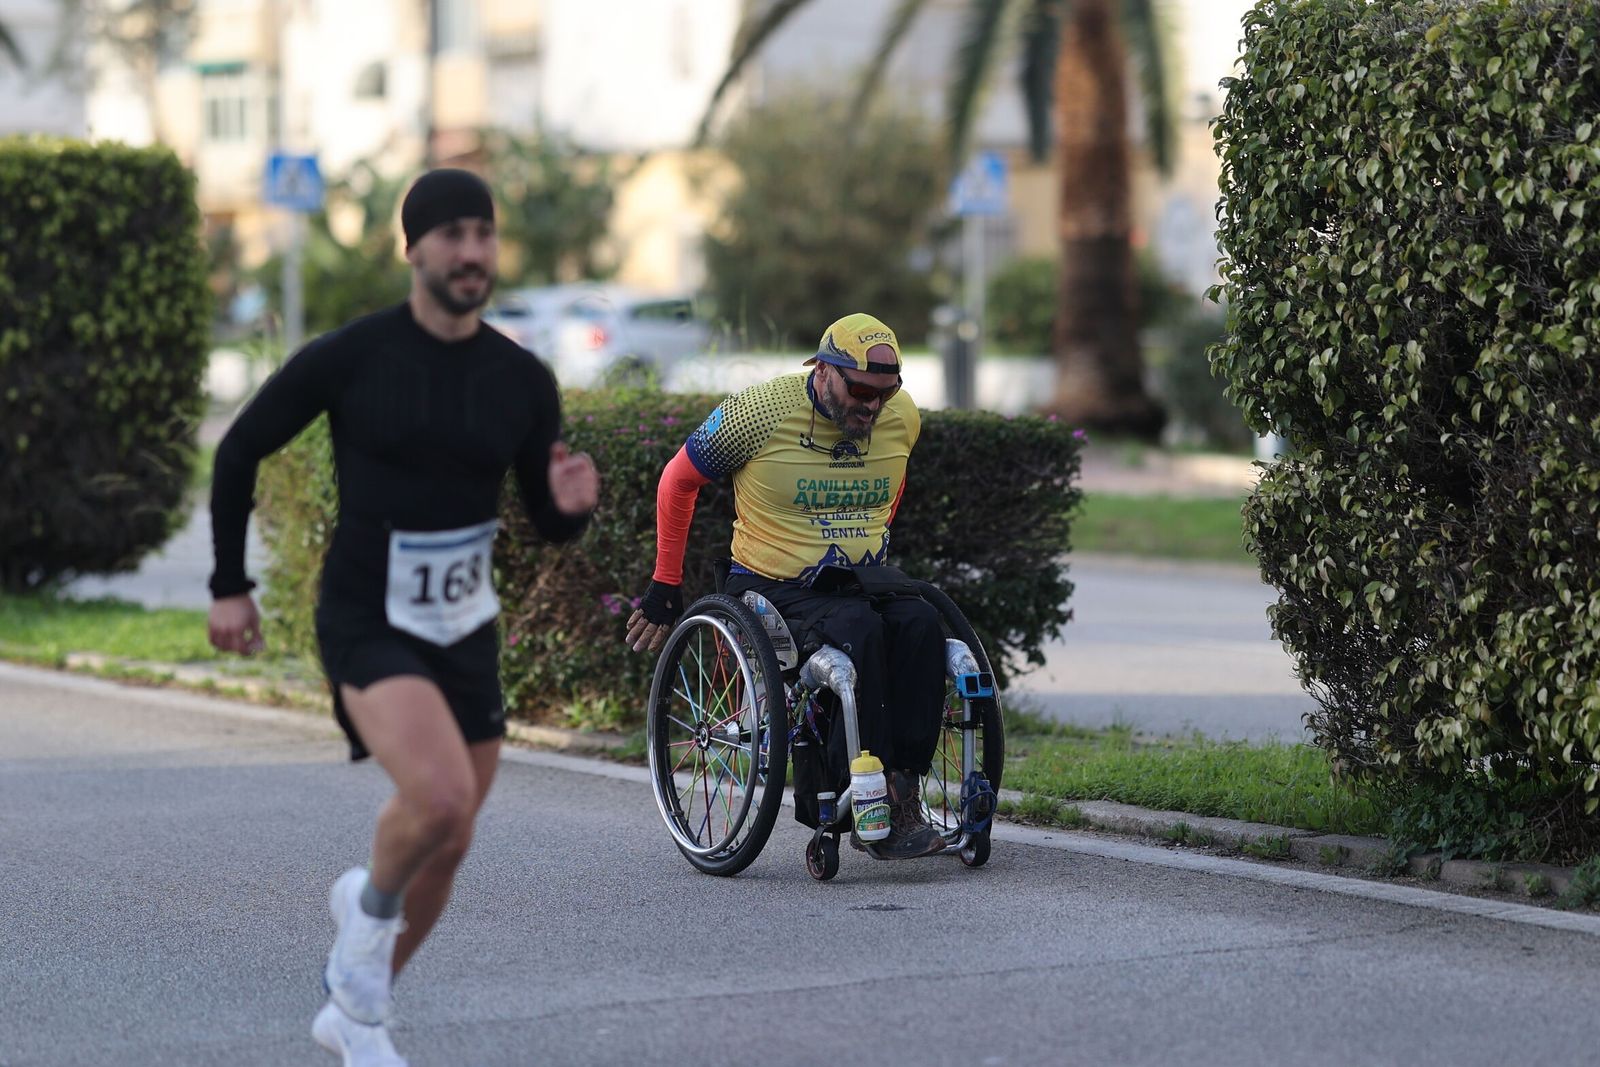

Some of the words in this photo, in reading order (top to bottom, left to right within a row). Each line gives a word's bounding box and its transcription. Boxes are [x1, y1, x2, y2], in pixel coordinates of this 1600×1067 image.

[796, 478, 869, 492] CANILLAS
[874, 476, 890, 491] DE
[793, 491, 890, 508] ALBAIDA
[821, 527, 870, 539] DENTAL
